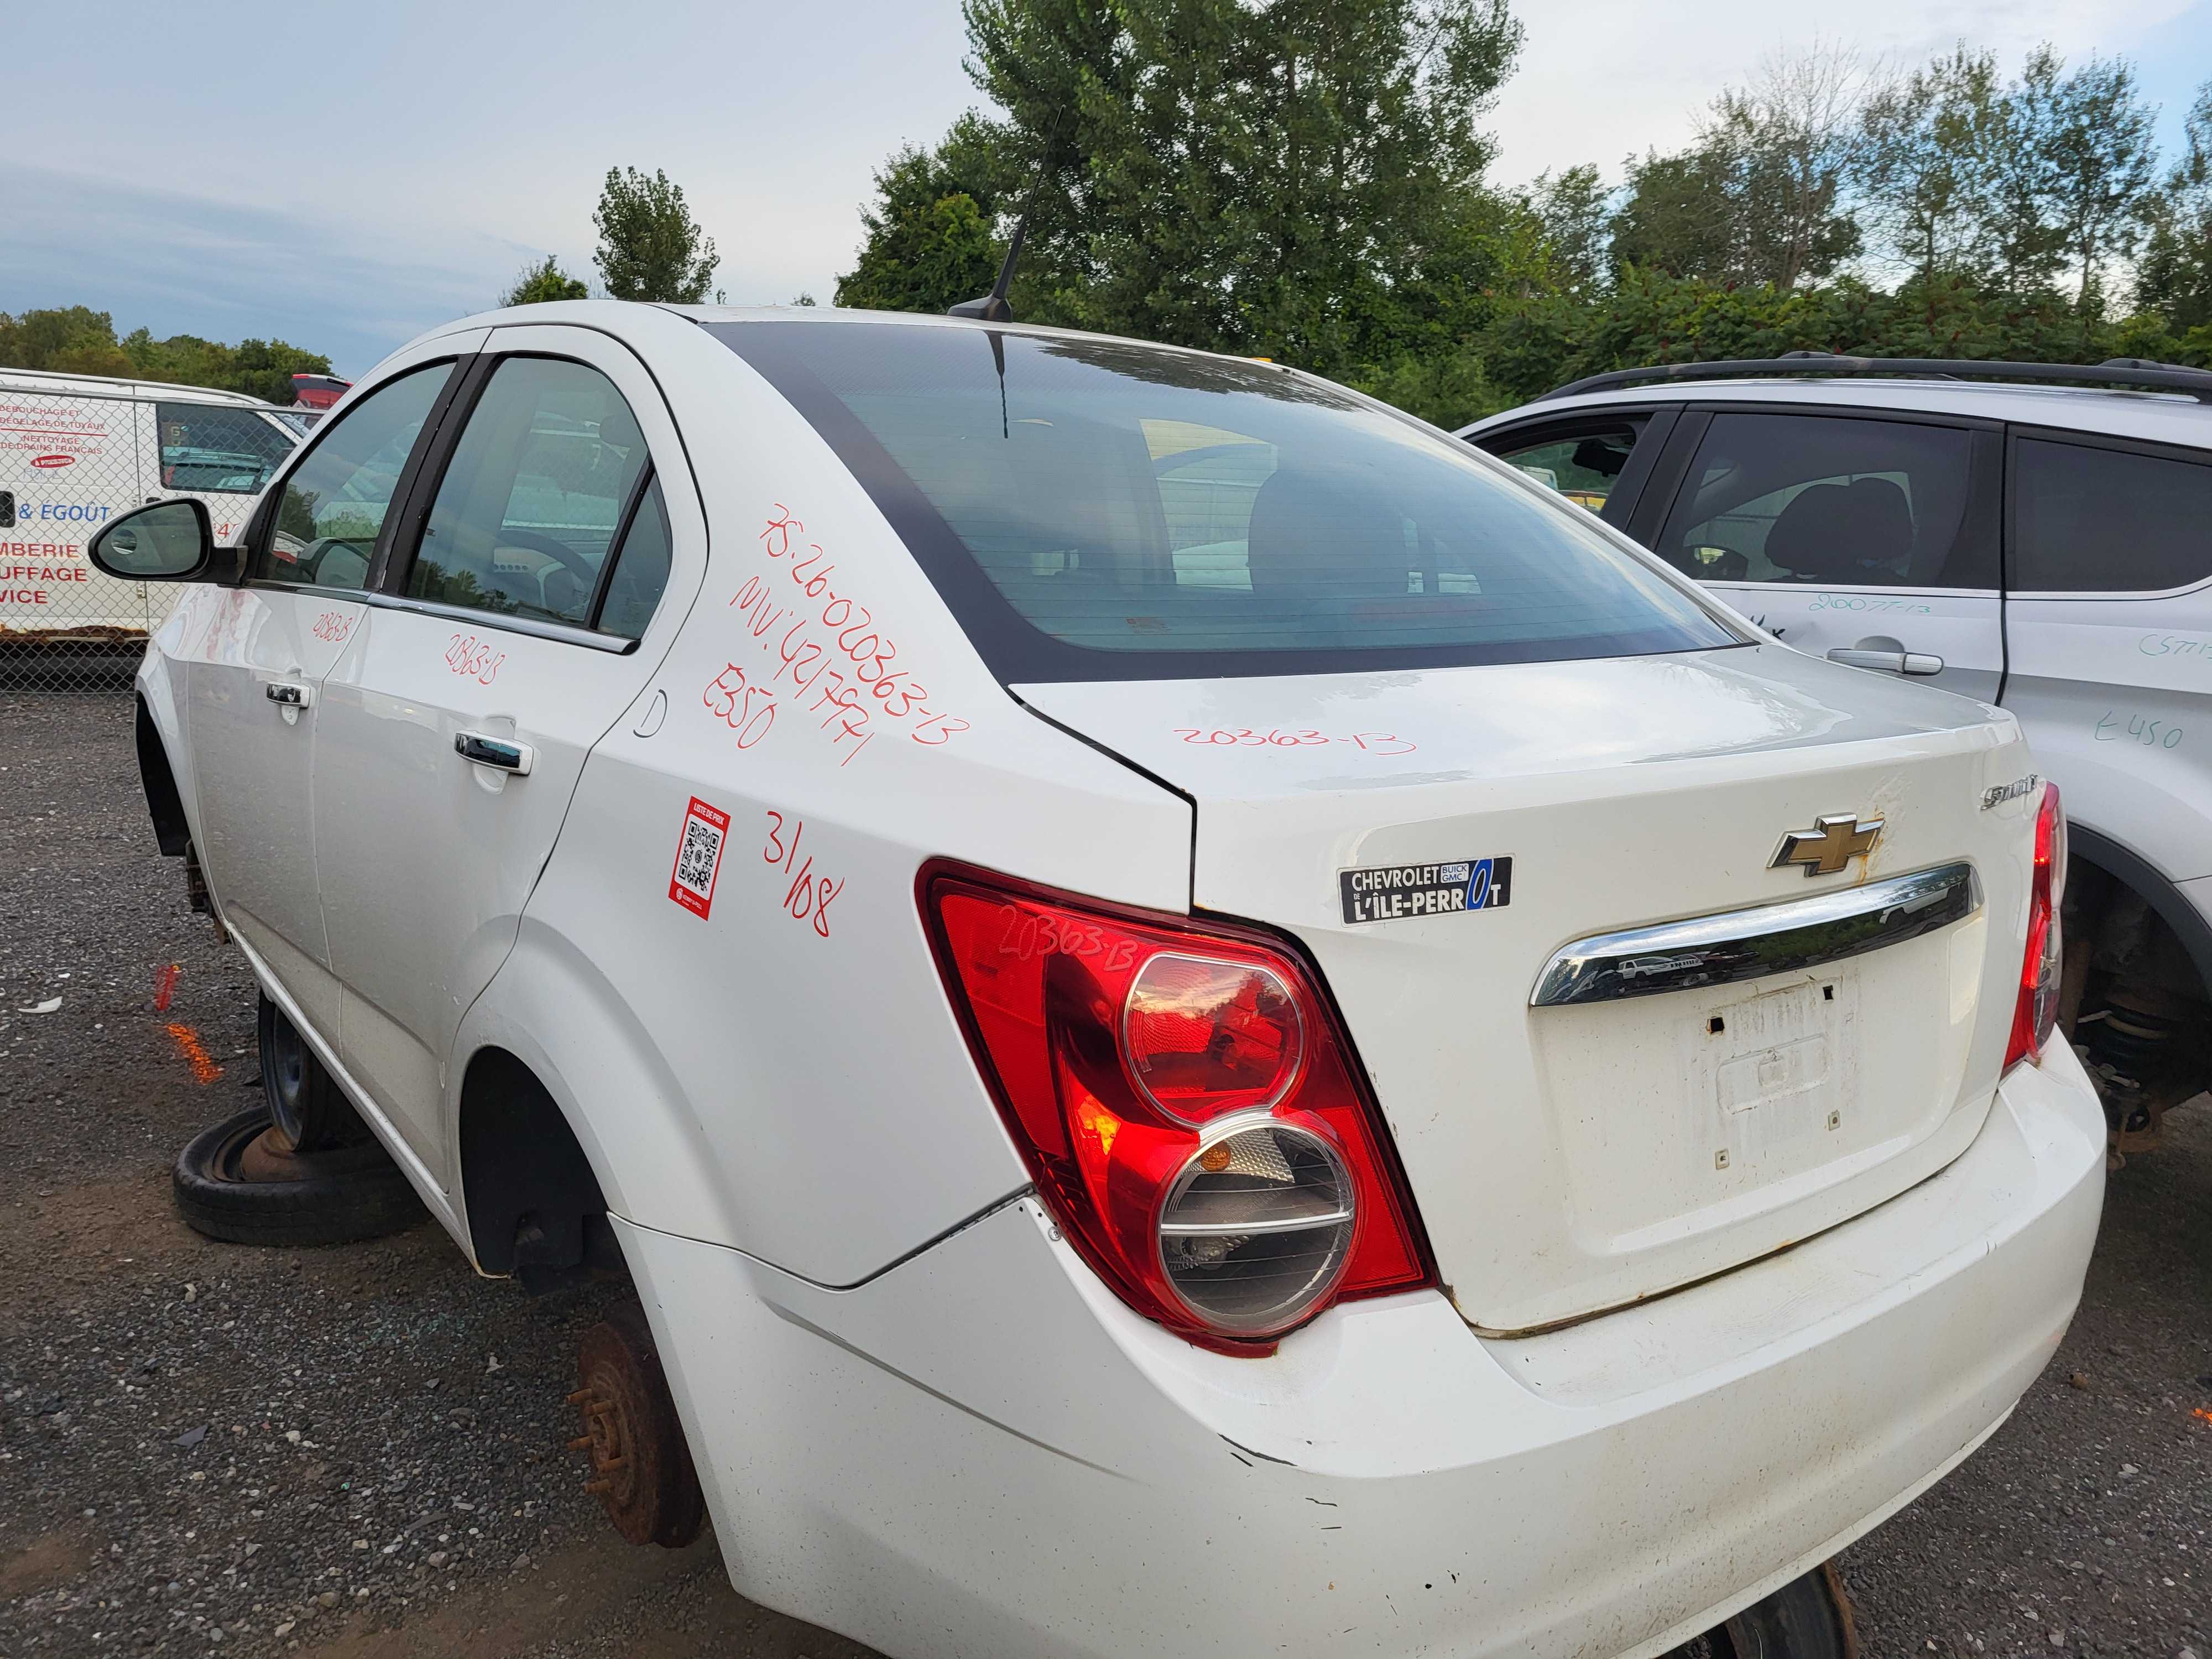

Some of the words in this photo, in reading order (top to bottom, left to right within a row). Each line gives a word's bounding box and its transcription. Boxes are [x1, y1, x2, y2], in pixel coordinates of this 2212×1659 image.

[70, 421, 106, 430] TUYAUX
[23, 435, 80, 445] NETTOYAGE
[17, 443, 53, 452] DRAINS
[41, 499, 111, 522] ÉGOÛT
[706, 809, 714, 820] DE
[1352, 865, 1439, 891] CHEVROLET
[1442, 864, 1468, 874] BUICK
[1442, 873, 1463, 882] GMC
